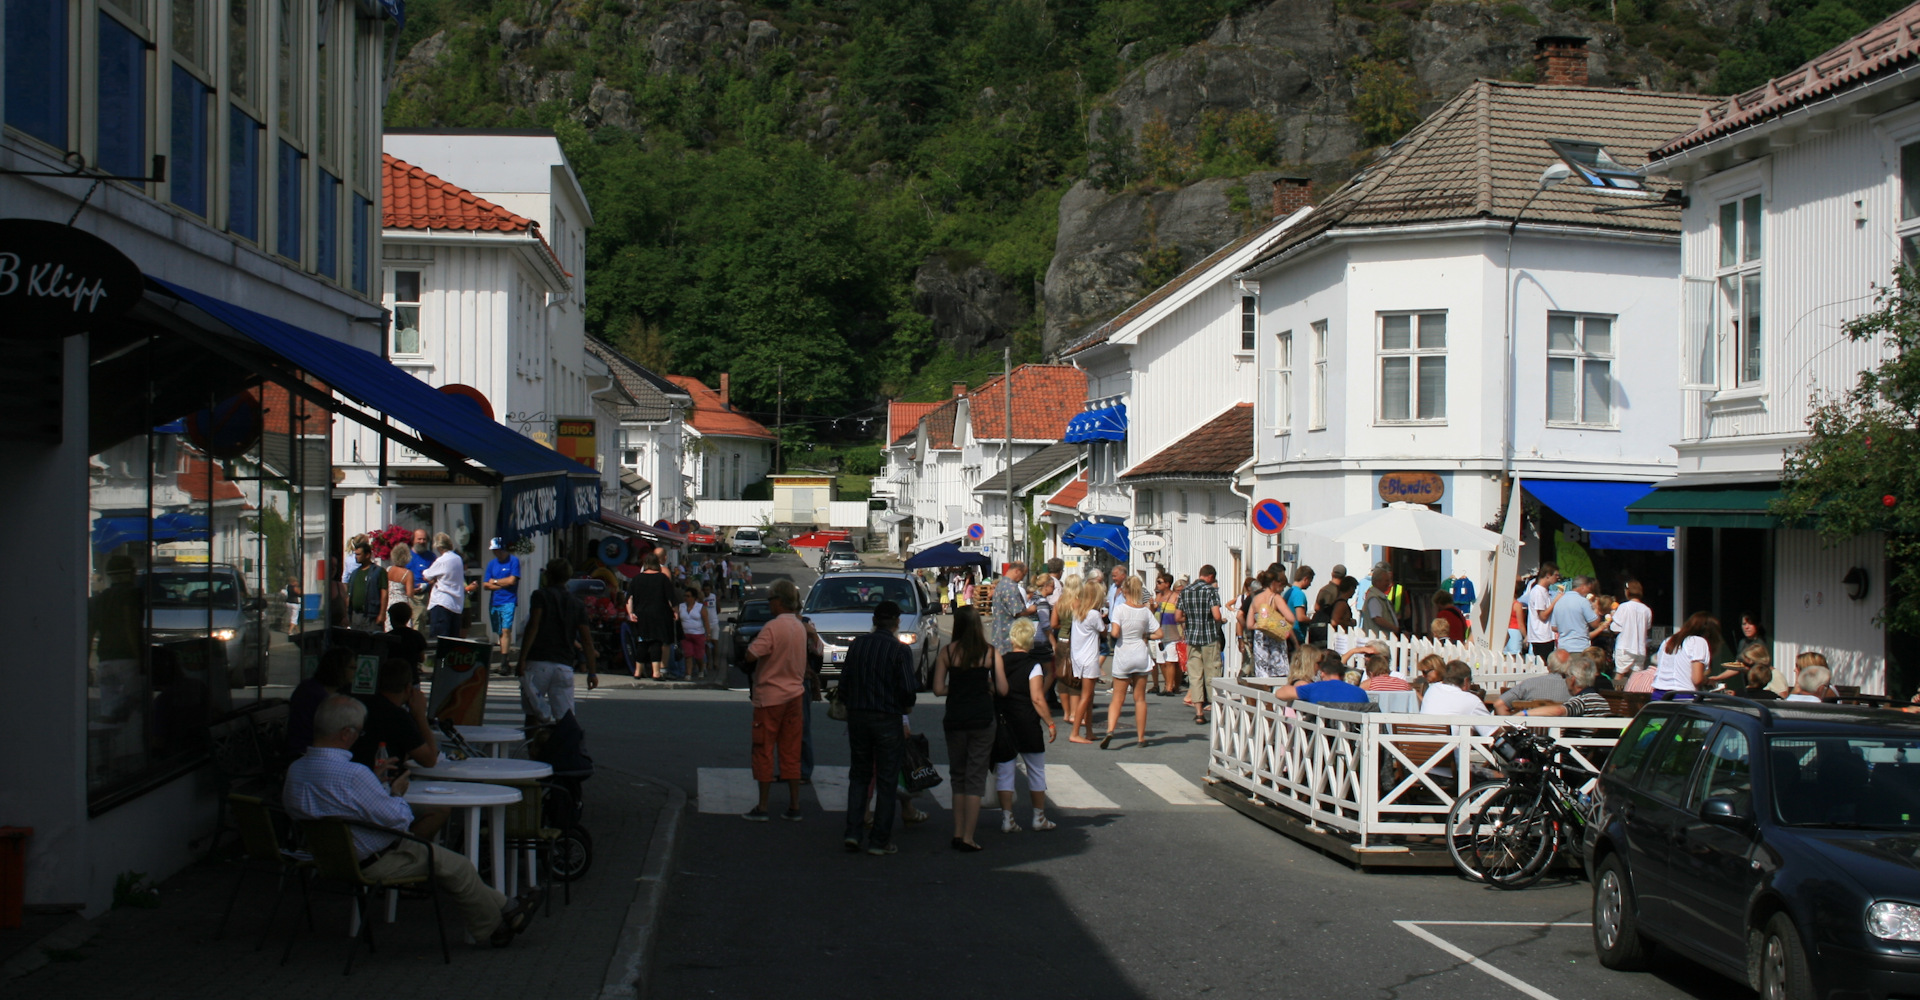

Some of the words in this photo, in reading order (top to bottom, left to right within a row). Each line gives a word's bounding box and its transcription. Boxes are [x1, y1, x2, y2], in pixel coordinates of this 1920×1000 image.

[26, 261, 109, 314] Klipp
[559, 425, 590, 436] BRIO
[1502, 540, 1517, 558] PASS
